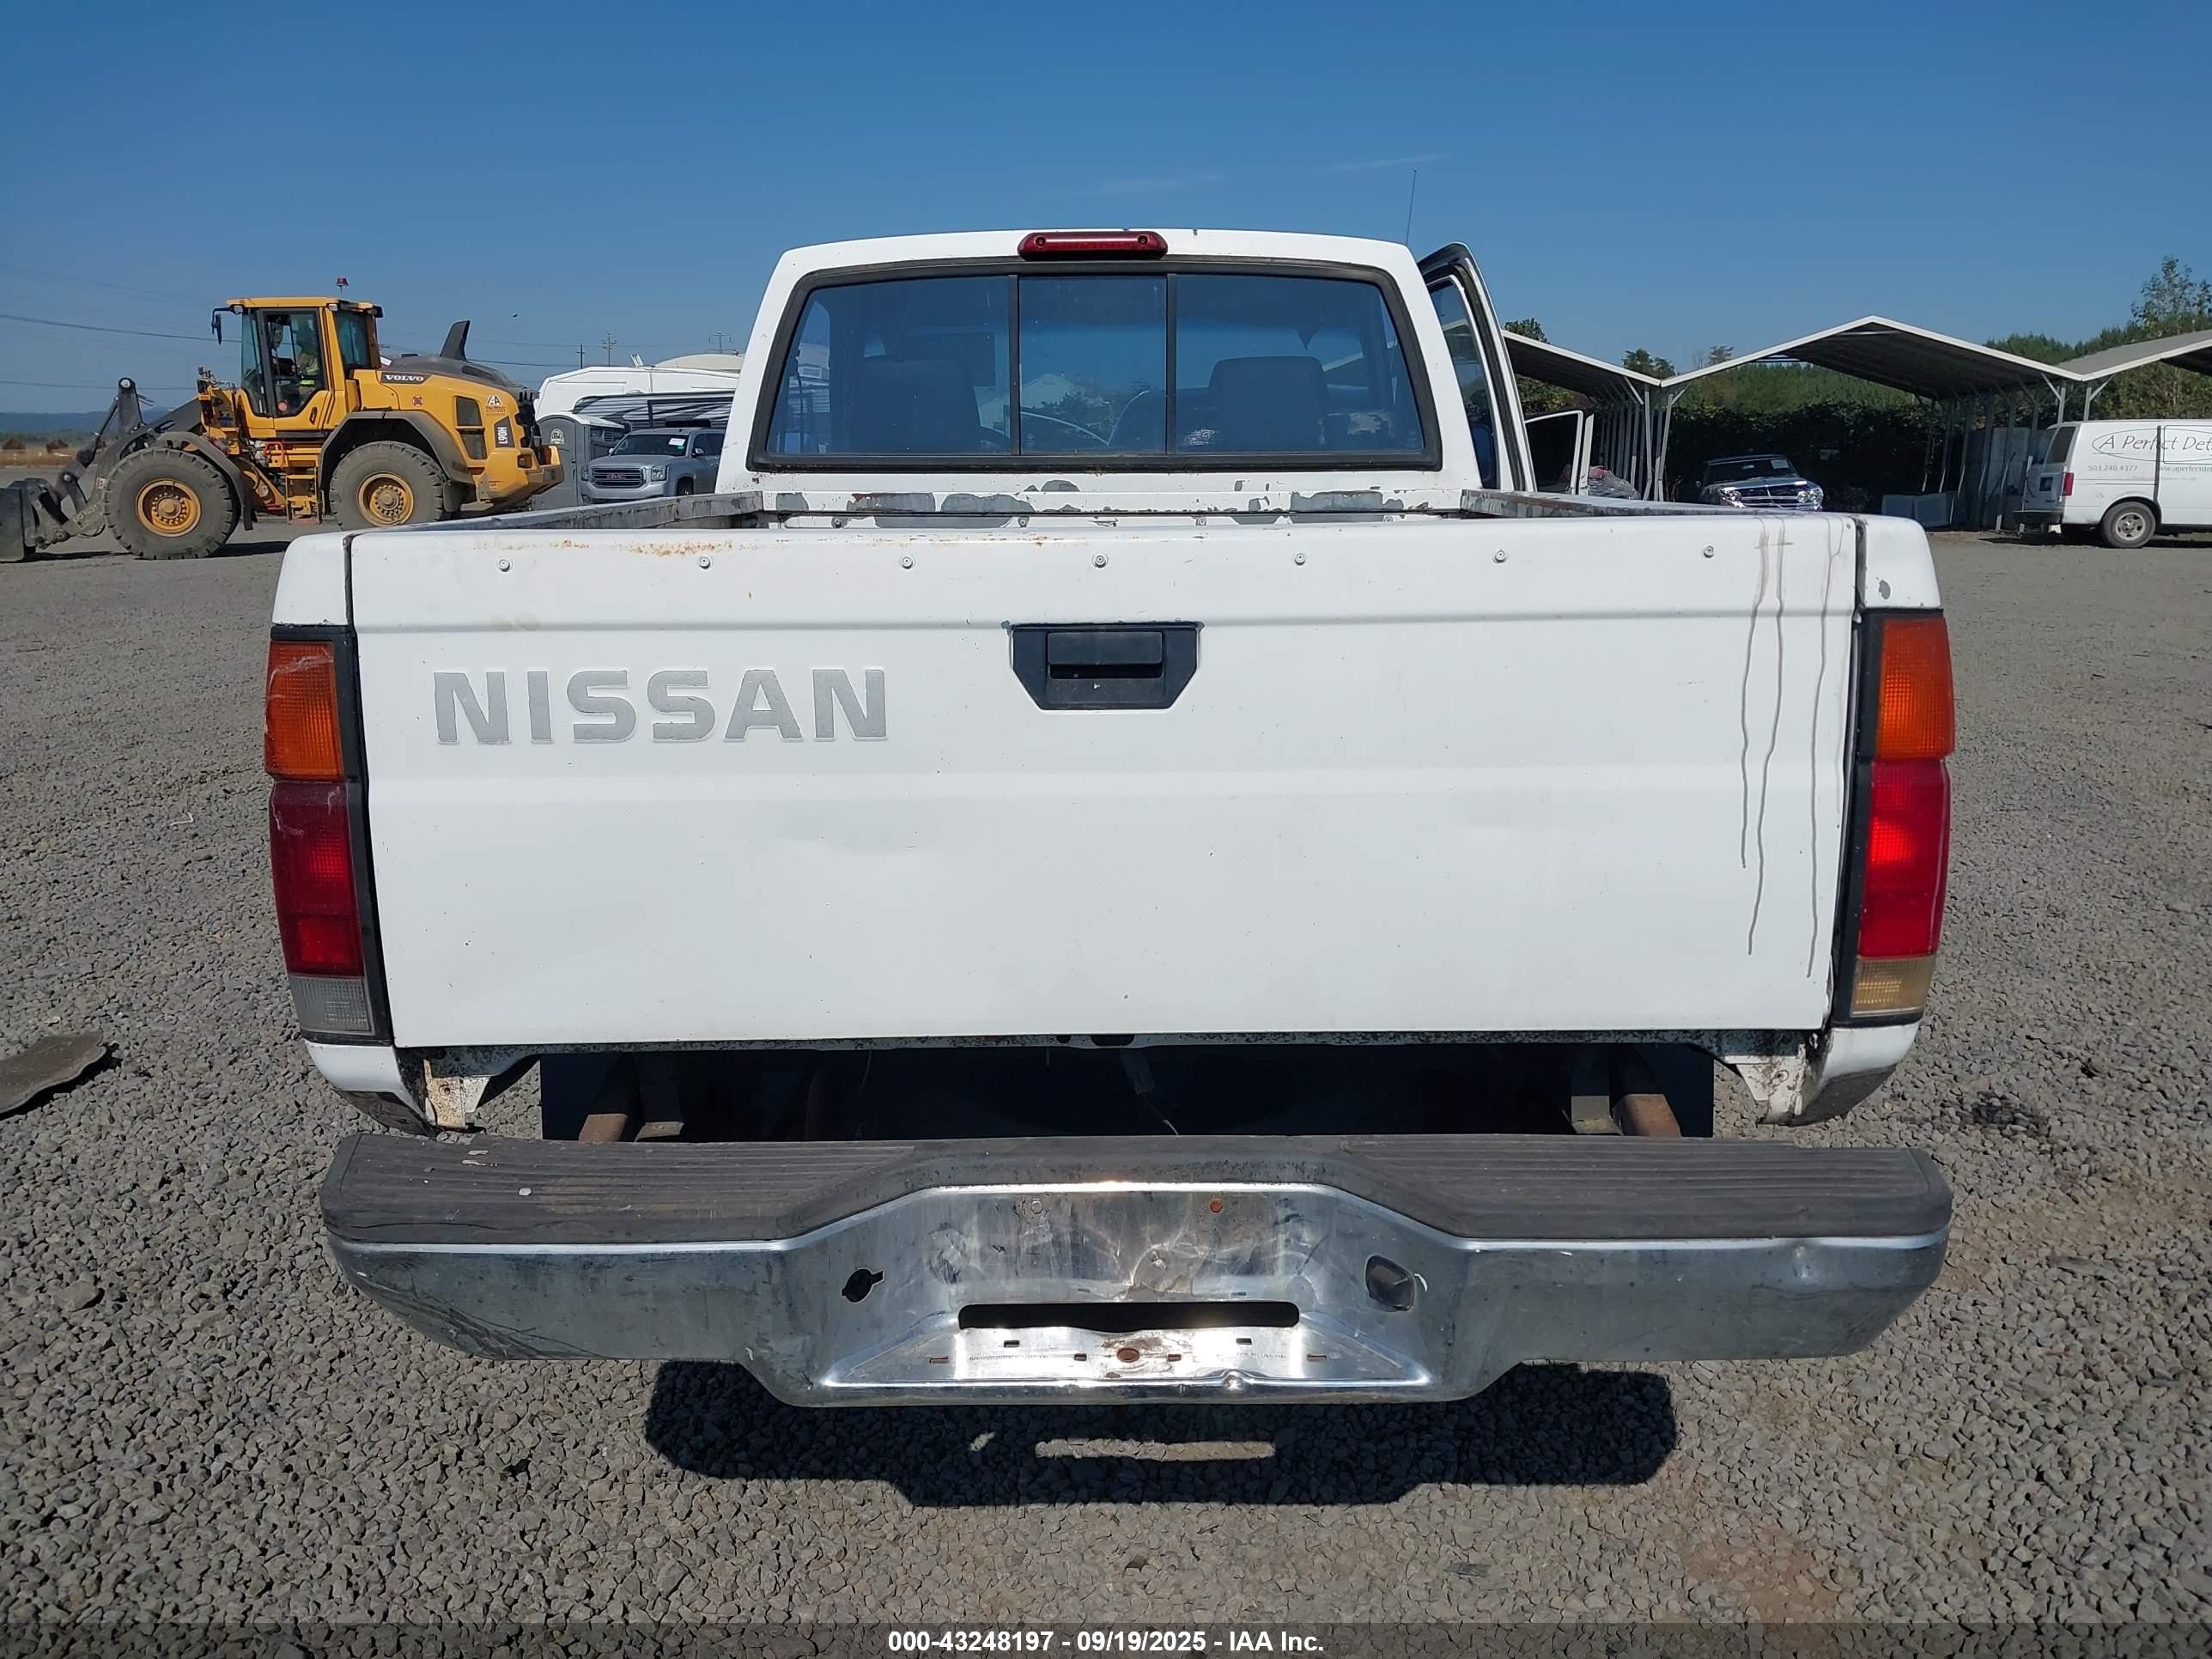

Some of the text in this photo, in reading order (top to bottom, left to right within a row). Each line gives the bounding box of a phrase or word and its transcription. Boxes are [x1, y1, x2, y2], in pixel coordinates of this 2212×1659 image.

[497, 427, 508, 444] L90H
[2099, 434, 2212, 451] A Perfct Det
[433, 668, 889, 743] NISSAN
